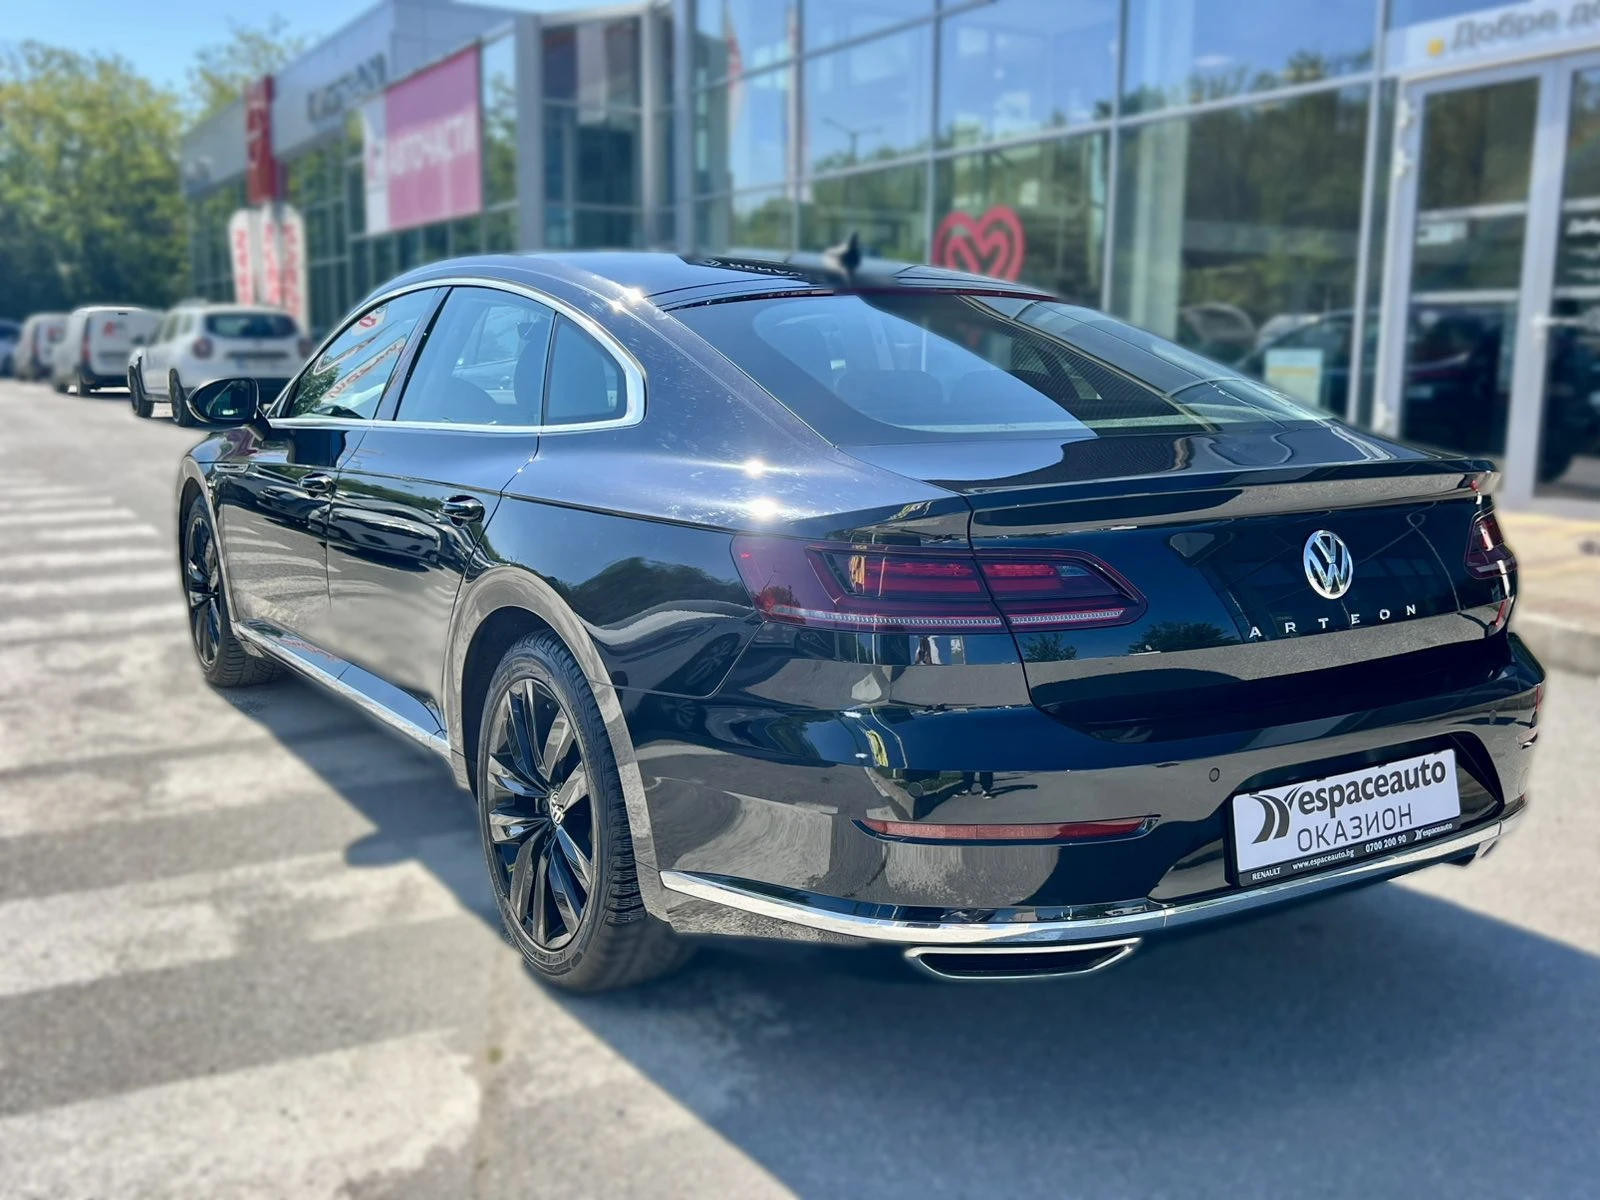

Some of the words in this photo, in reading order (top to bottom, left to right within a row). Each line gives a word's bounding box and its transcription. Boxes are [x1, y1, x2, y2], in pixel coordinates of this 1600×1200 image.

[1453, 10, 1558, 50] Добре
[1249, 604, 1416, 639] ARTEON
[1297, 803, 1413, 852] ОКАЗИОН
[1251, 866, 1281, 881] RENAULT
[1292, 849, 1355, 870] www.espaceauto.bg
[1365, 840, 1383, 853] 0700
[1384, 837, 1397, 849] 200
[1397, 834, 1407, 845] 90
